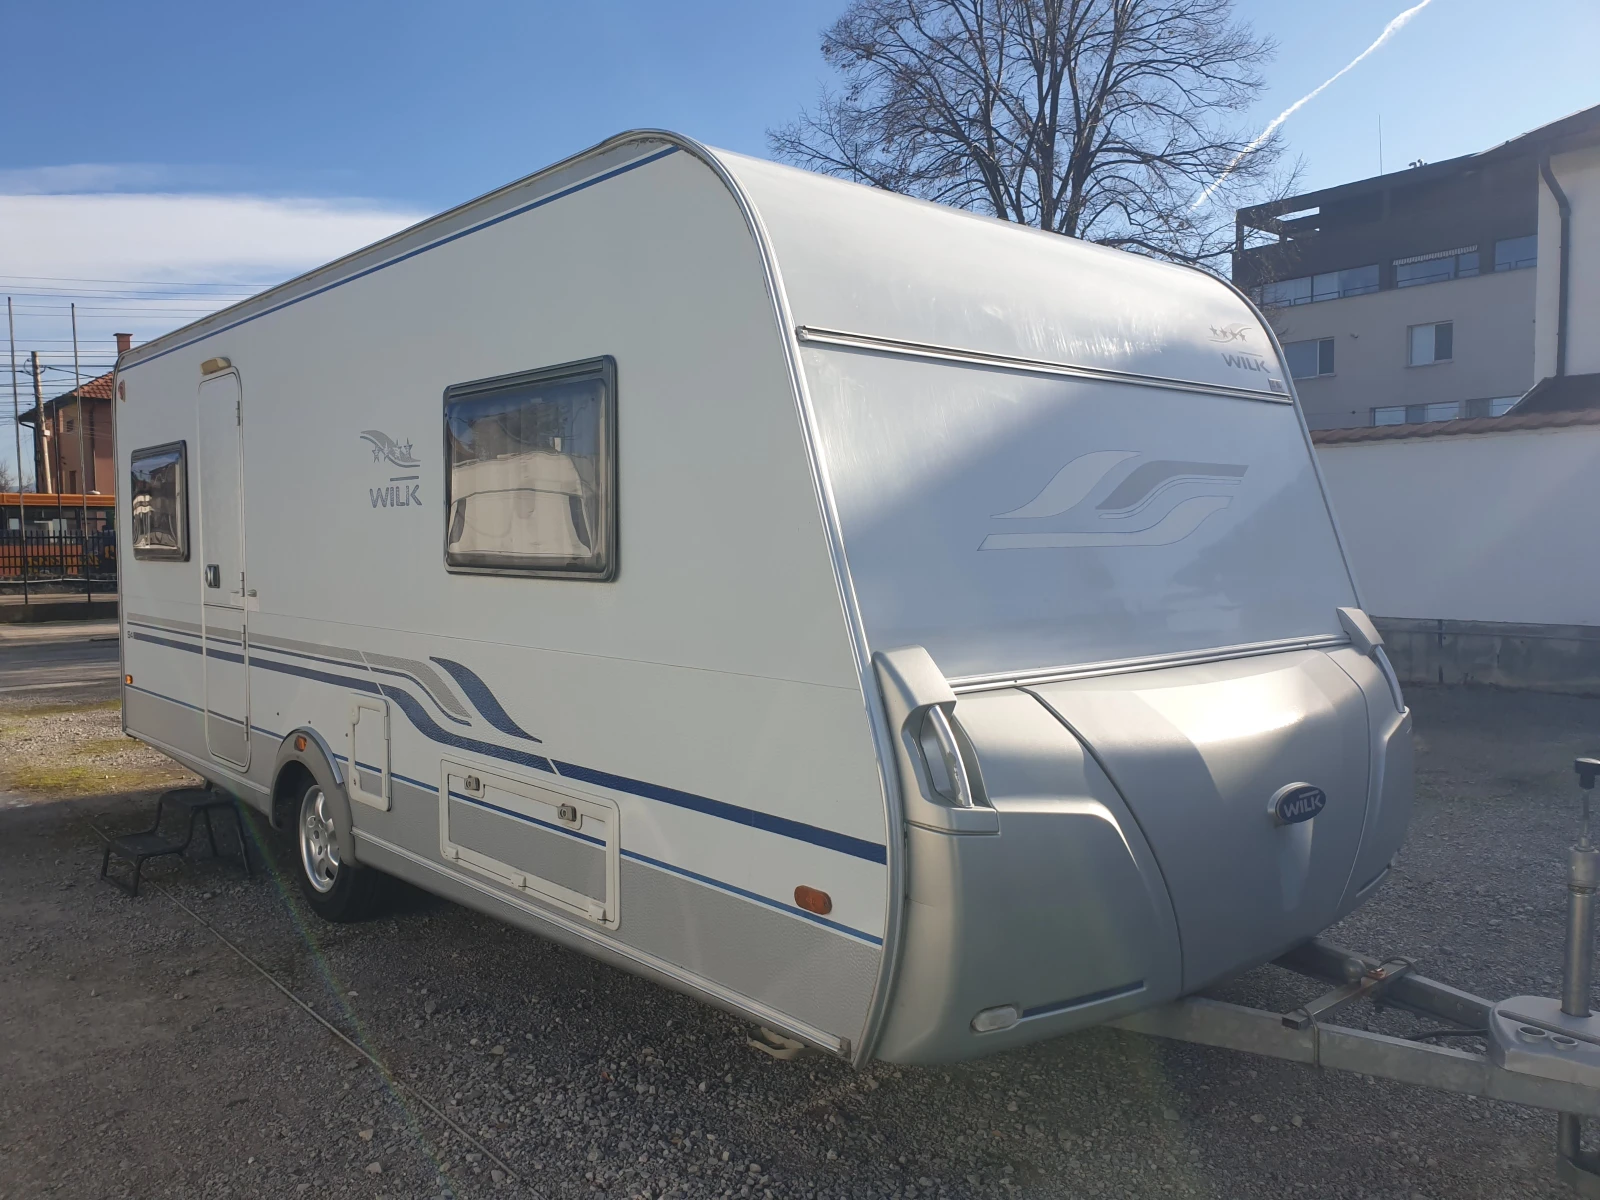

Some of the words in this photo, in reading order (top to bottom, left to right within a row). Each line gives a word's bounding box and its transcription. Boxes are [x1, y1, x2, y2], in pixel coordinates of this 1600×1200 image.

[1221, 352, 1271, 374] WILK
[369, 484, 422, 508] WILK
[1283, 794, 1323, 818] WILK
